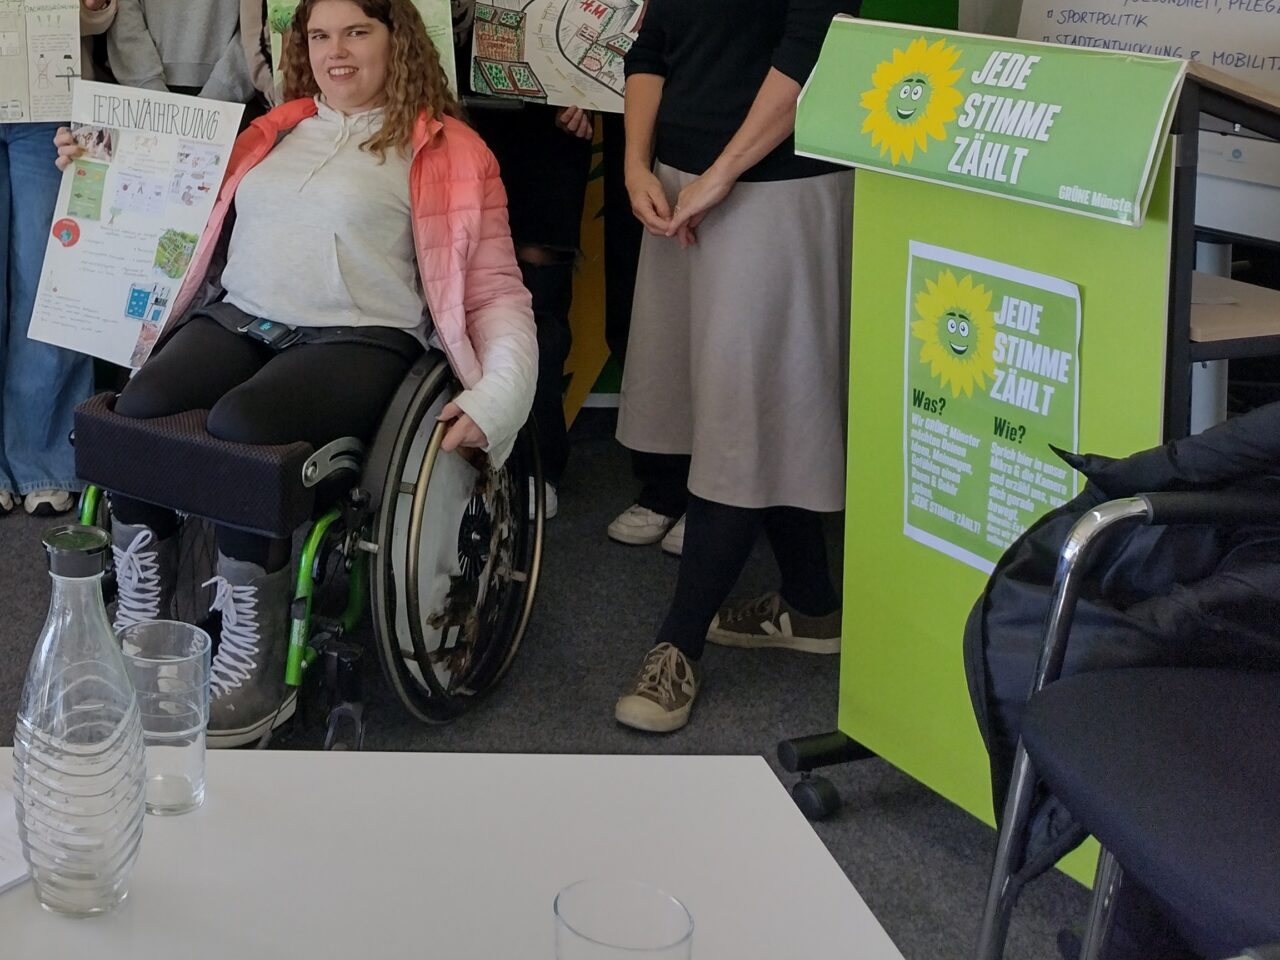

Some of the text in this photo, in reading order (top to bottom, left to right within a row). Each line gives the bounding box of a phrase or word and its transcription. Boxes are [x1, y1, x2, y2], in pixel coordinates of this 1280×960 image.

[1057, 10, 1149, 28] SPORTPOLITIK
[971, 50, 1042, 90] JEDE
[92, 94, 220, 141] ERNÄHRUNG
[958, 93, 1062, 141] STIMME
[947, 133, 1029, 185] ZÄHLT
[1058, 185, 1091, 205] GRÜNE
[994, 295, 1043, 336] JEDE
[992, 331, 1072, 383] STIMME
[912, 388, 947, 416] Was?
[990, 368, 1055, 417] ZÄHLT
[993, 416, 1026, 444] Wie?
